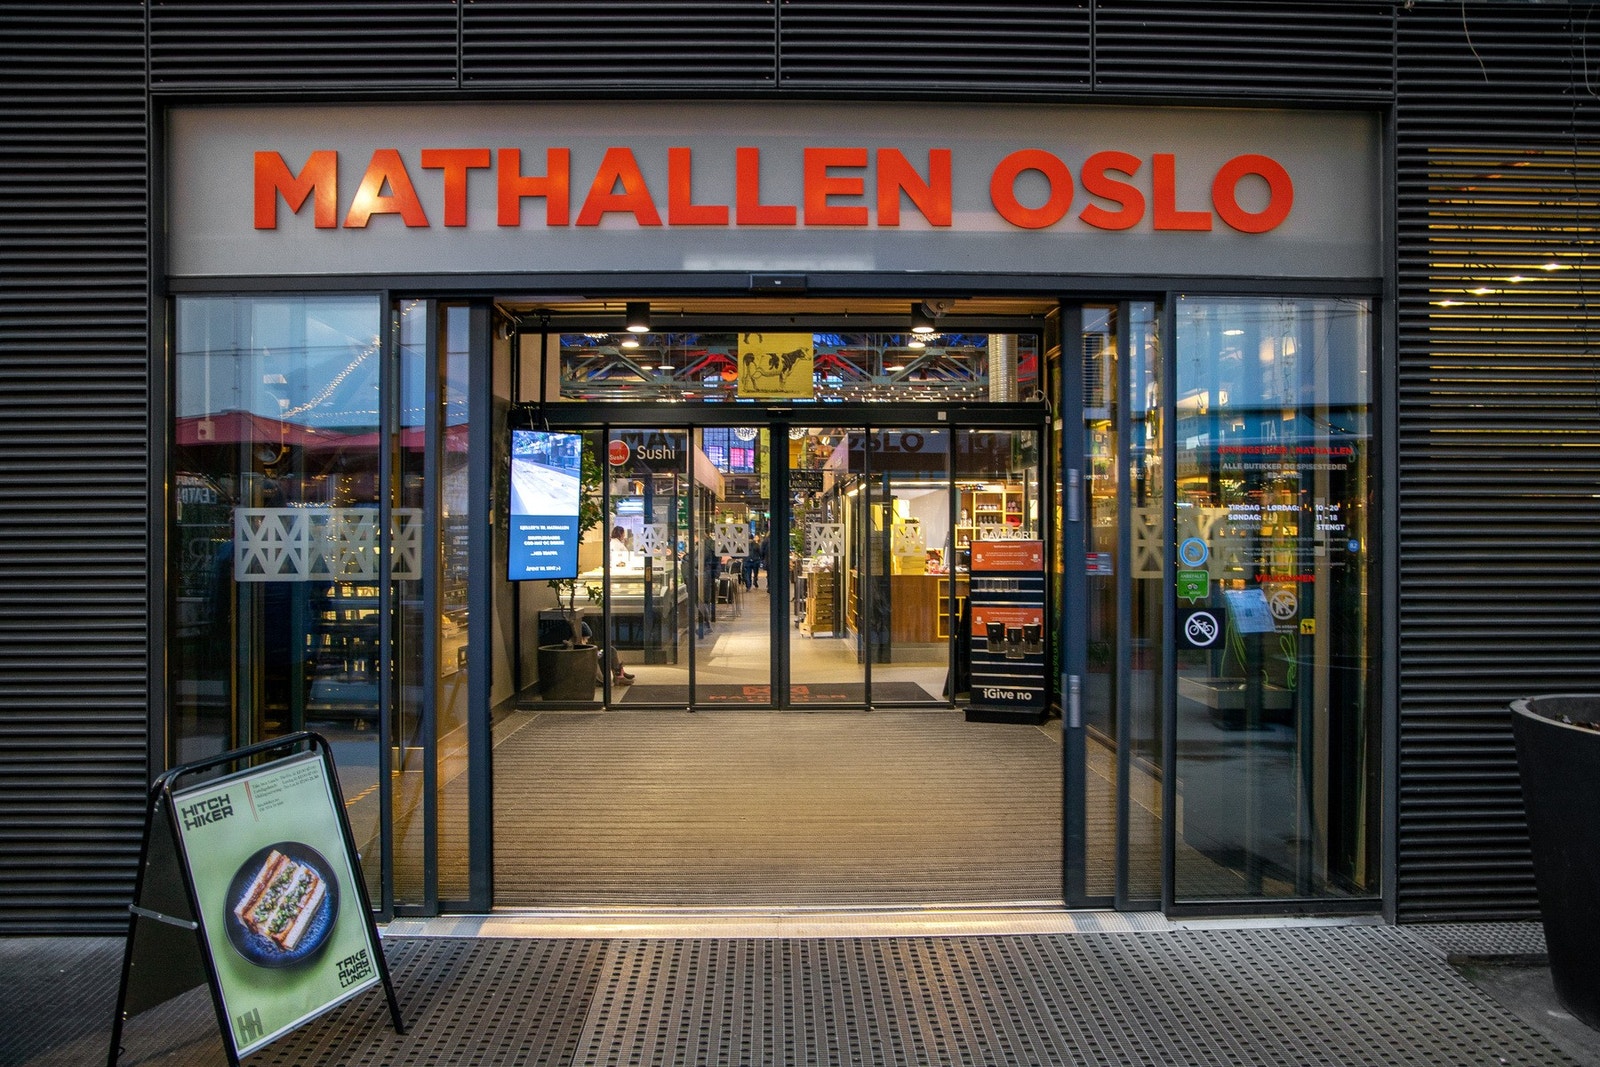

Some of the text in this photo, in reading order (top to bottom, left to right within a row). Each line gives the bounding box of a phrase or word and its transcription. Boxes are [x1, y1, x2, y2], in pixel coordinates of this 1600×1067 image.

[253, 147, 1294, 233] MATHALLEN OSLO
[637, 445, 676, 460] Sushi
[1222, 462, 1242, 470] ALLE
[1243, 462, 1282, 470] BUTIKKER
[1296, 463, 1348, 471] SPISESTEDER
[1228, 504, 1261, 512] TIRSDAG
[1267, 504, 1300, 512] LØRDAG:
[1330, 504, 1340, 512] 20
[1228, 513, 1262, 521] SØNDAG:
[1316, 523, 1346, 531] STENGT
[1255, 574, 1316, 583] VELKOMMEN
[983, 688, 1032, 700] iGive no
[181, 793, 232, 819] HITCH
[184, 805, 235, 831] HIKER
[336, 949, 367, 970] TAKE
[338, 958, 370, 981] AWAY
[340, 966, 372, 988] LUNCH
